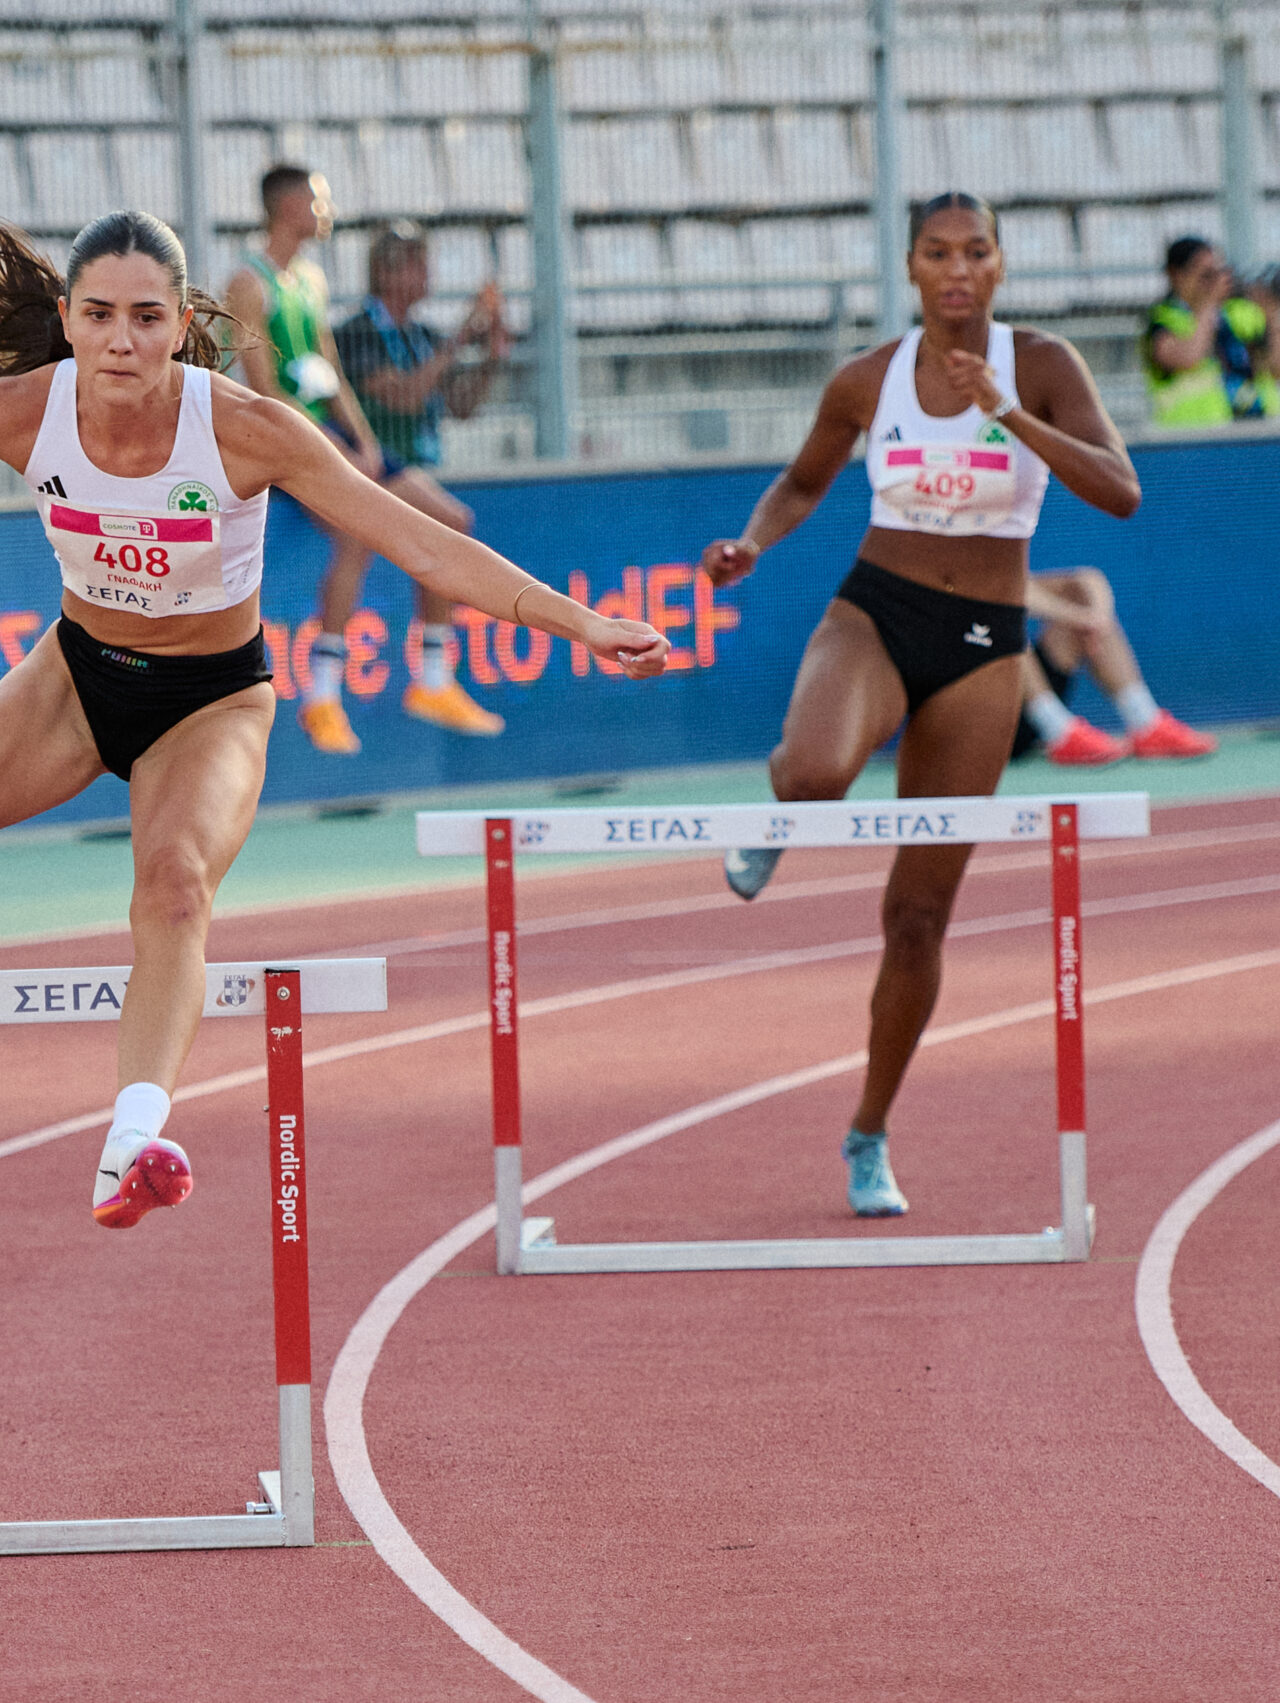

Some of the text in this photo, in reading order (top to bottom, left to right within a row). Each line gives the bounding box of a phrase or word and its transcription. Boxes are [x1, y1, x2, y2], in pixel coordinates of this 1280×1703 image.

[915, 472, 976, 500] 409
[94, 541, 170, 578] 408
[107, 573, 162, 592] ΓΝΑΦΑΚΗ
[86, 585, 153, 612] ΣΕΓΑΣ
[605, 812, 957, 843] ΣΕΓΑΣ ΣΕΓΑΣ
[13, 981, 129, 1013] ΣΕΓΑ
[277, 1185, 300, 1243] Sport
